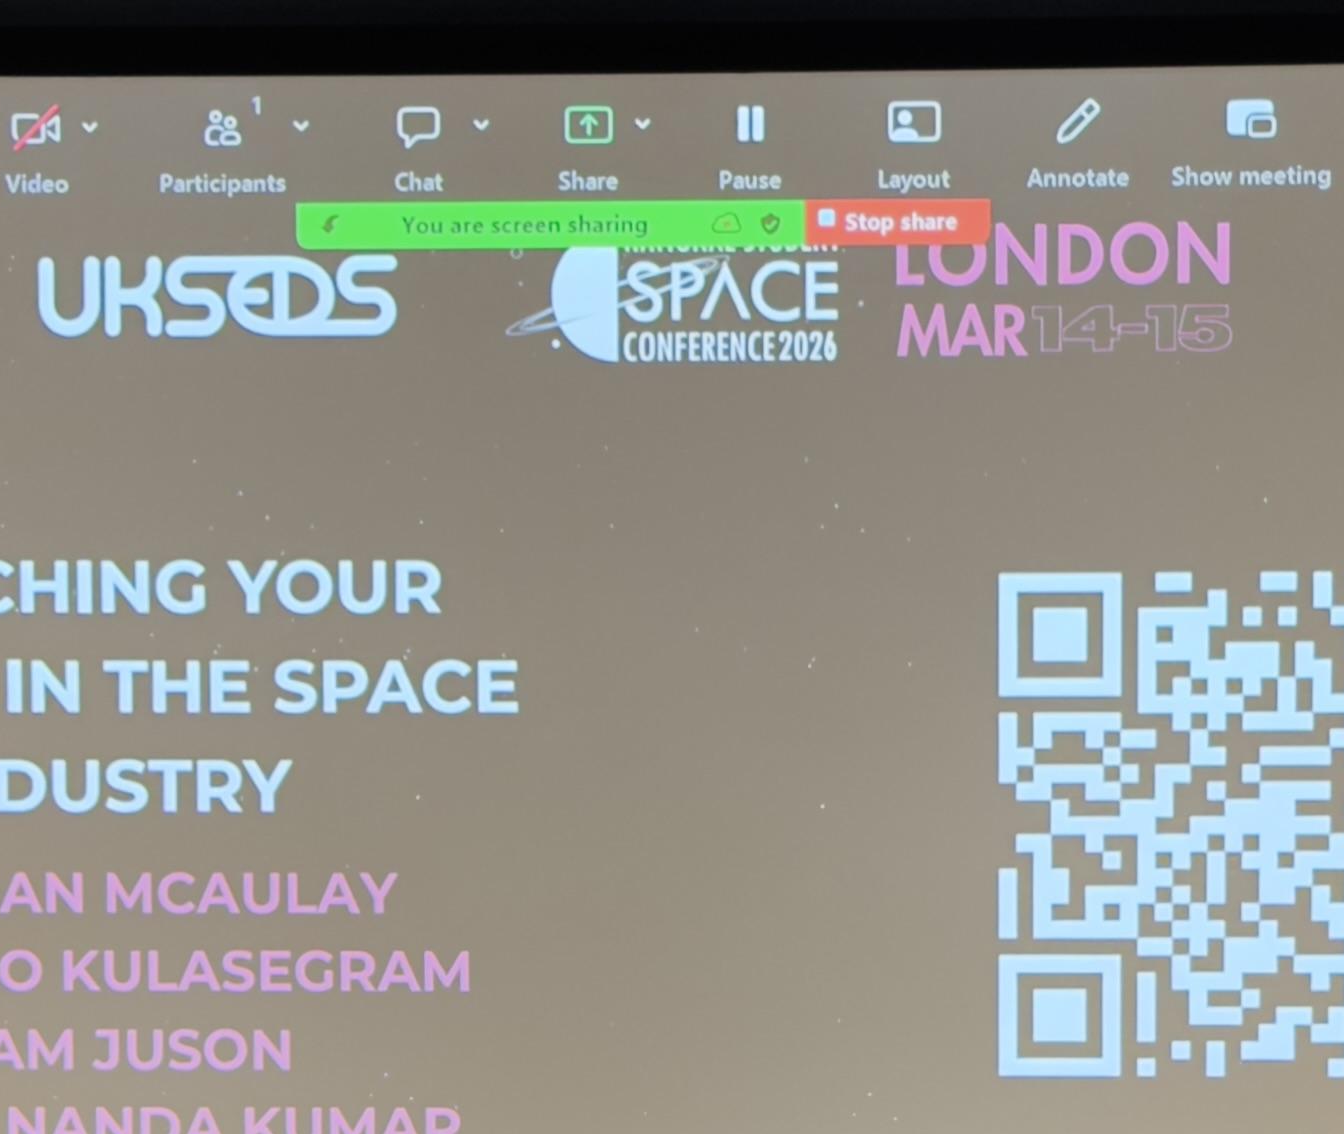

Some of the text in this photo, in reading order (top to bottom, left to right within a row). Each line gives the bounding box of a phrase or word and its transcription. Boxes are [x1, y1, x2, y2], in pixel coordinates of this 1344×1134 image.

[251, 95, 262, 116] 1
[4, 172, 70, 194] Video
[159, 172, 287, 198] Participants
[394, 170, 444, 193] Chat
[558, 169, 619, 191] Share
[719, 169, 782, 191] Pause
[878, 168, 951, 195] Layout
[1026, 167, 1130, 188] Annotate
[1171, 164, 1333, 192] Show meeting
[402, 214, 649, 238] You are screen sharing
[845, 210, 959, 237] Stop share
[896, 221, 1231, 287] LONDON
[37, 254, 398, 338] UKSEDS
[623, 260, 839, 323] SPACE
[896, 303, 1233, 357] MAR 14-15
[623, 330, 838, 362] CONFERENCE 2026
[226, 559, 442, 615] YOUR
[6, 658, 81, 714] IN
[102, 659, 252, 714] THE
[274, 658, 519, 714] SPACE
[105, 871, 398, 915] MCAULAY
[62, 949, 471, 993] KULASEGRAM
[91, 1028, 291, 1072] JUSON
